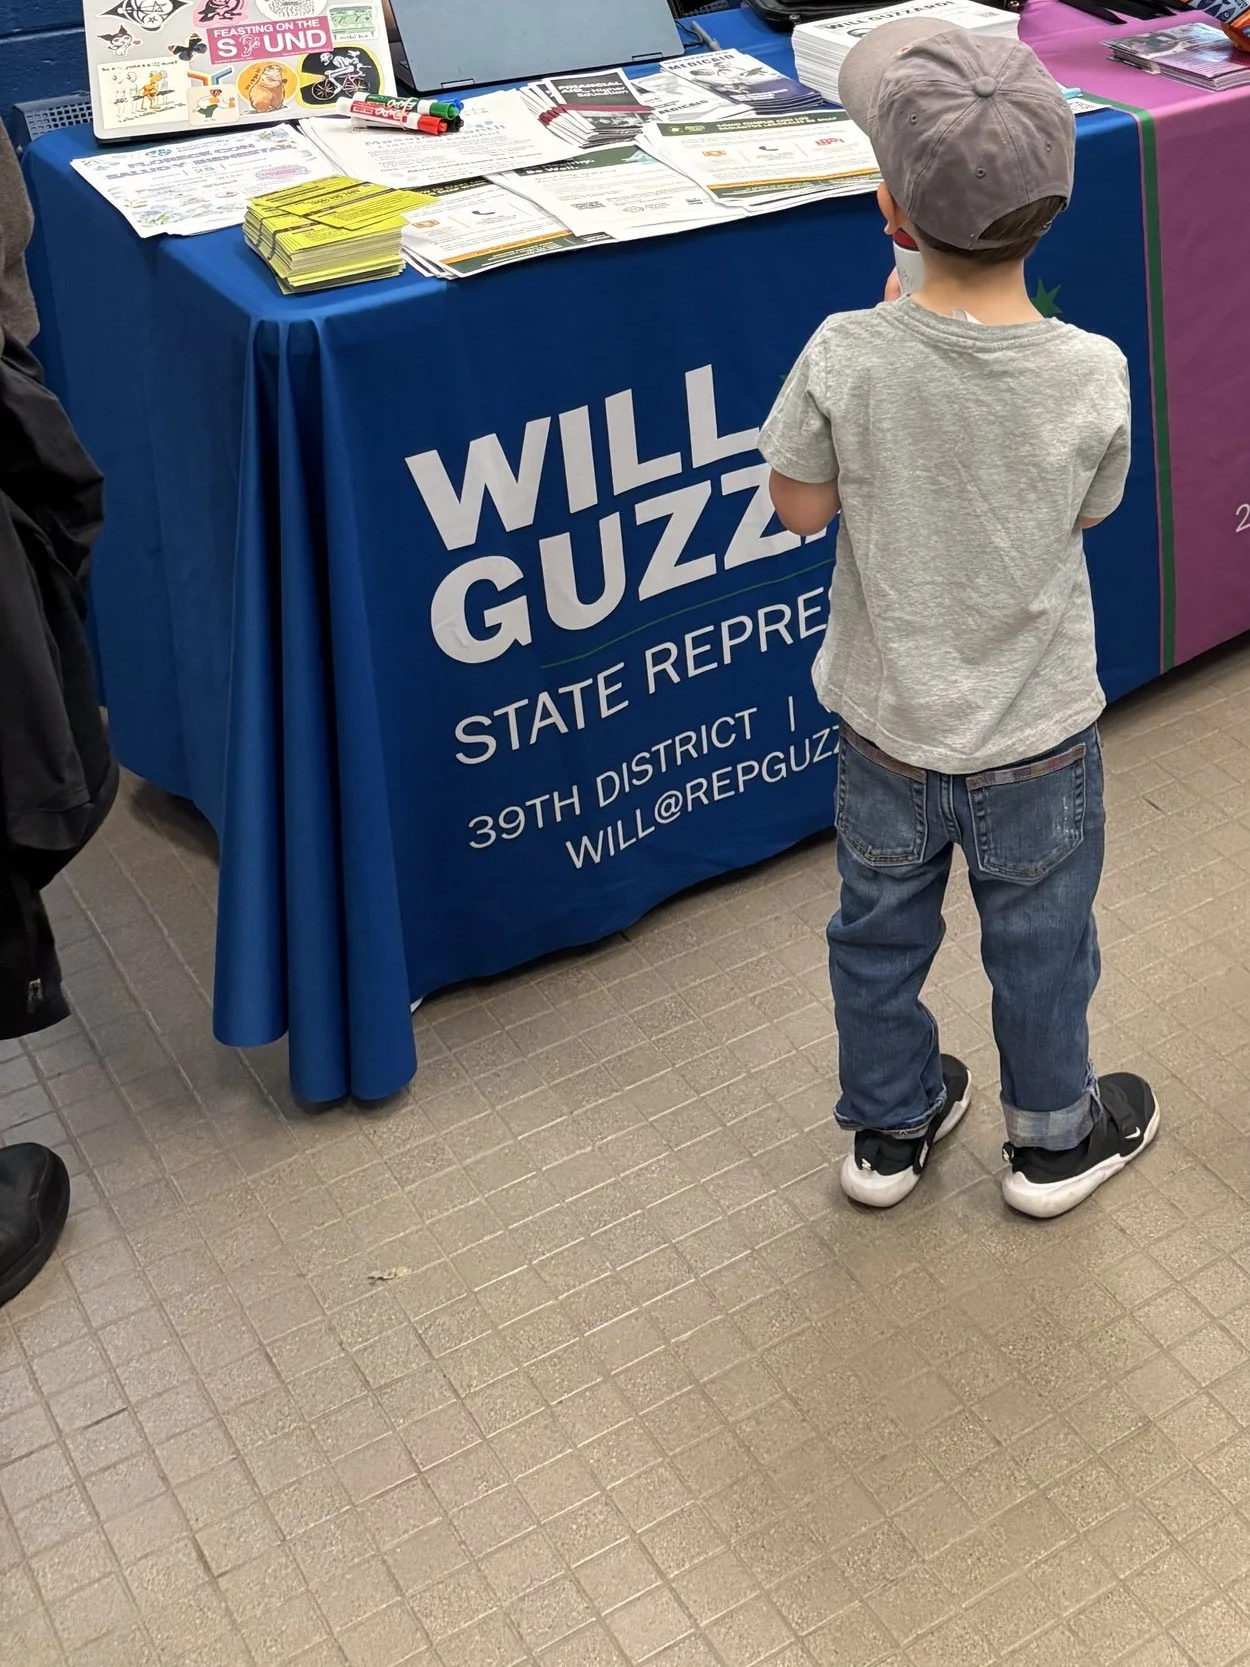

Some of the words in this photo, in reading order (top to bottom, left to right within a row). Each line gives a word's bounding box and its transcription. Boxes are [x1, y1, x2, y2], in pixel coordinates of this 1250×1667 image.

[213, 24, 274, 38] FEASTING
[276, 22, 294, 32] ON
[296, 18, 321, 29] THE
[825, 19, 864, 30] WILL
[869, 0, 955, 24] GUZZARDI
[216, 29, 327, 57] SUND
[668, 53, 735, 71] MEDICAID
[214, 143, 256, 157] CON
[405, 363, 760, 552] WILL
[430, 462, 830, 665] GUZZ
[454, 662, 628, 765] STATE
[647, 586, 829, 695] REPRE
[469, 783, 582, 850] 39TH
[596, 706, 759, 805] DISTRICT
